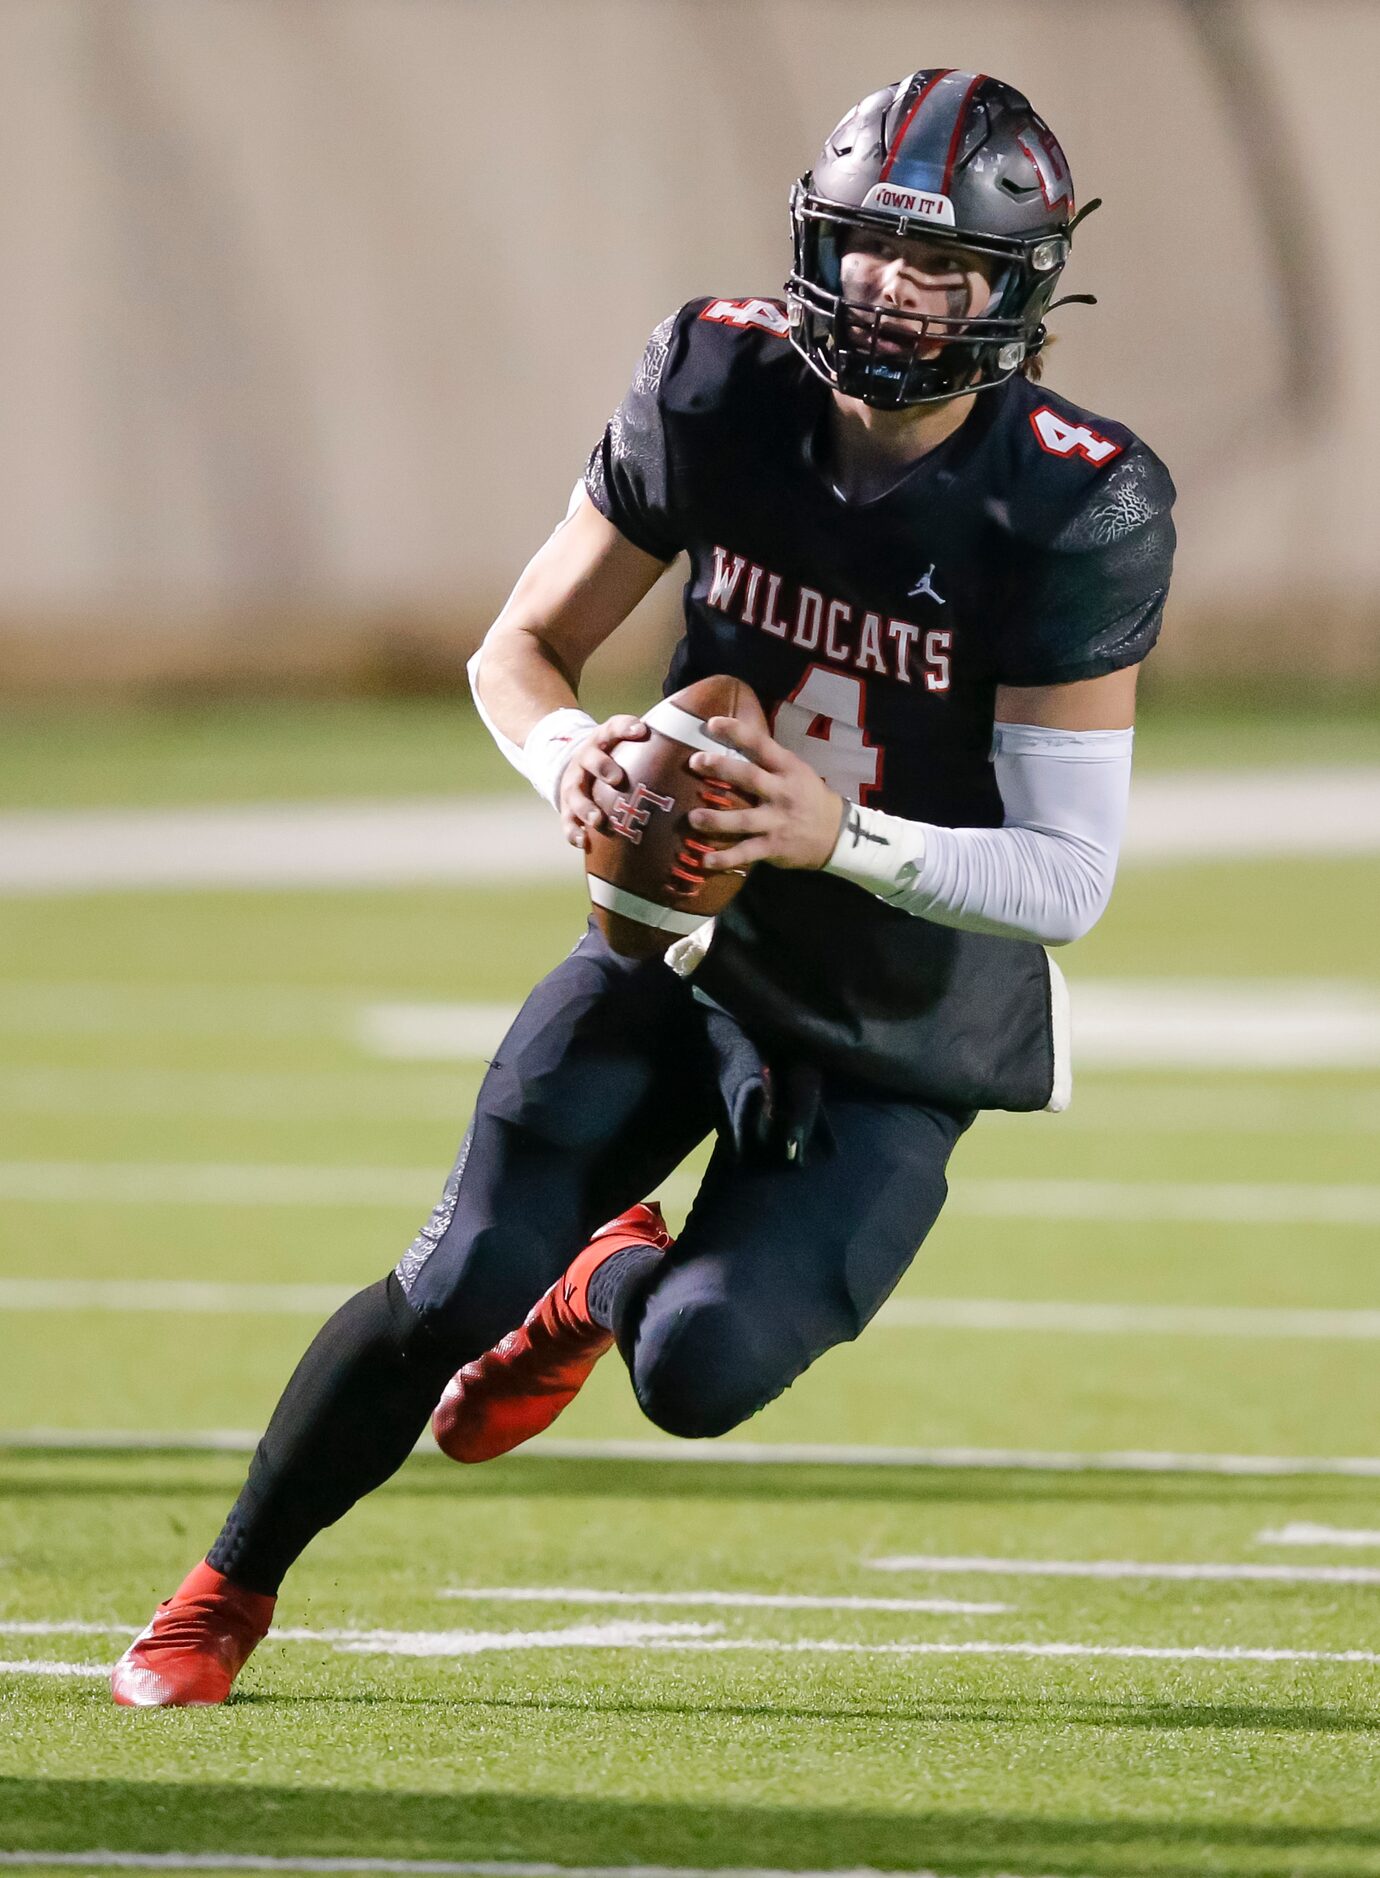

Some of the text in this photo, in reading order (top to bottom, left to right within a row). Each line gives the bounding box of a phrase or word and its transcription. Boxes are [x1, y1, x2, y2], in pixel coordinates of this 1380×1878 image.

[882, 191, 916, 210] OWN
[698, 298, 790, 339] 4
[1029, 405, 1123, 468] 4
[706, 544, 953, 692] WILDCATS
[769, 661, 886, 807] 4
